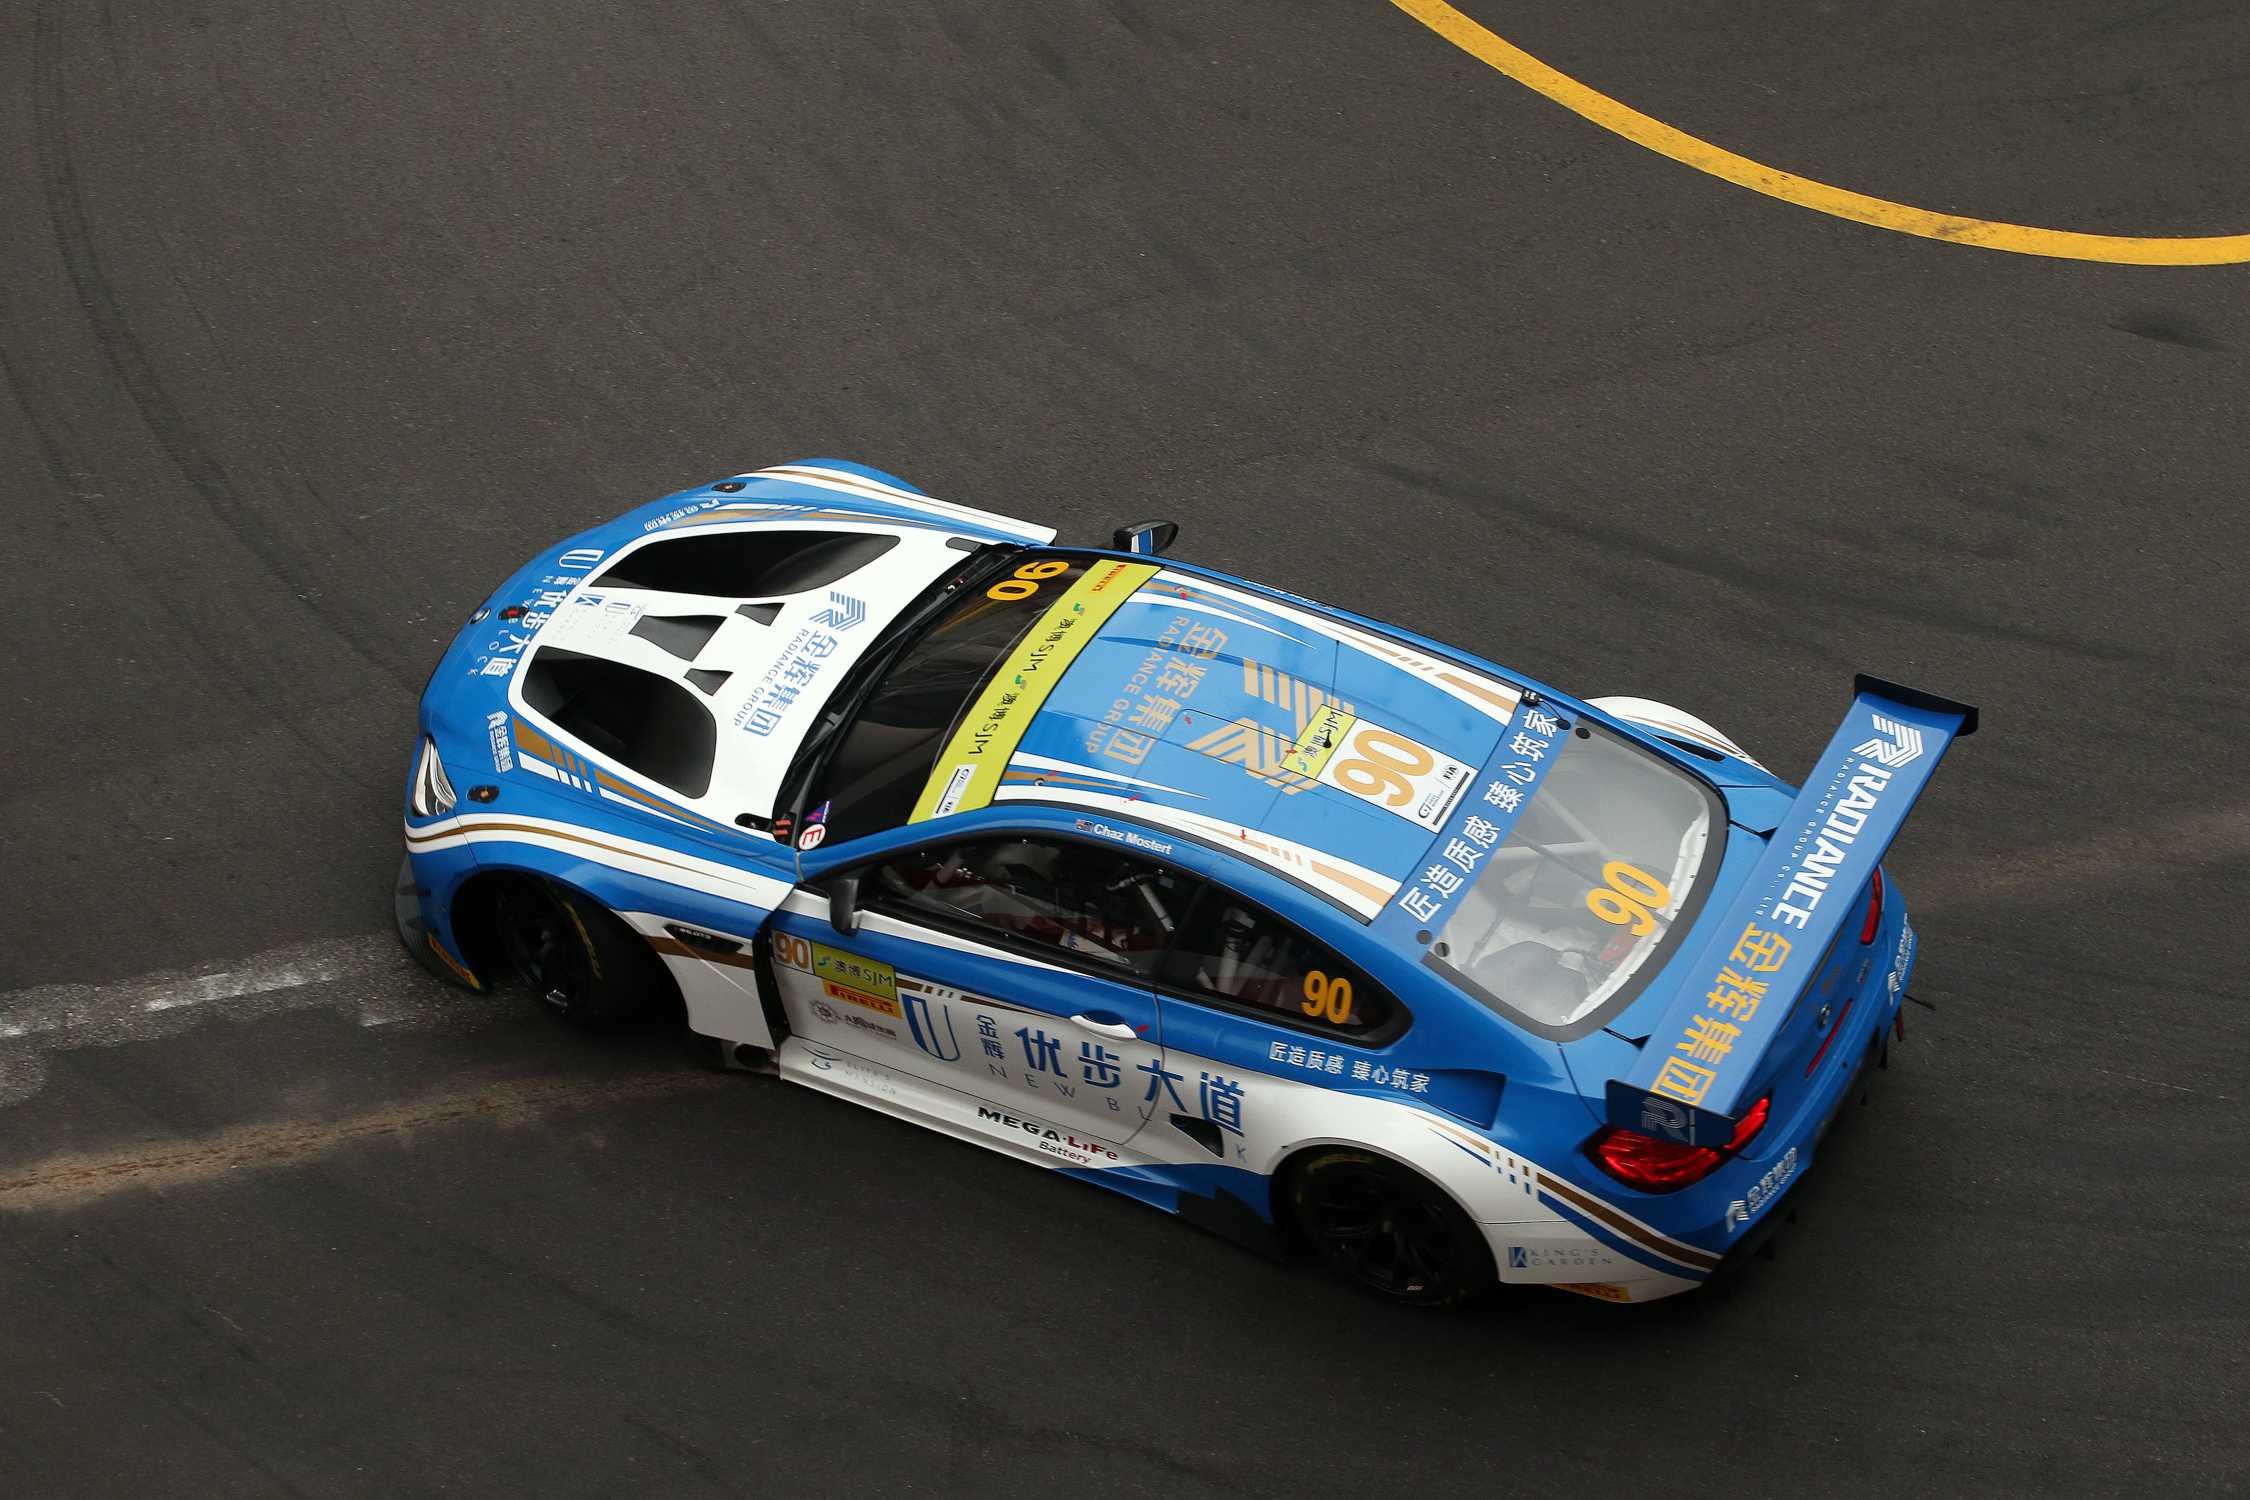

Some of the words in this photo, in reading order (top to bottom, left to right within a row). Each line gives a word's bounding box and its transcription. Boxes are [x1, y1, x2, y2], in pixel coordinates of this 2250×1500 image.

[986, 561, 1070, 601] 90
[743, 630, 838, 737] 金辉集团
[762, 628, 810, 685] RADIANCE
[1124, 615, 1190, 695] RADIANCE
[733, 686, 765, 727] GROUP
[1333, 729, 1434, 807] 90
[1815, 757, 1855, 815] RADIANCE
[1093, 823, 1125, 841] Chaz
[1125, 831, 1173, 855] Mostert
[1398, 814, 1500, 924] 匠造质感
[1483, 709, 1559, 814] 臻心筑家
[1790, 821, 1817, 858] GROUP
[1770, 762, 1893, 930] RADIANCE
[1585, 860, 1671, 937] 90
[774, 932, 809, 969] 90
[1301, 970, 1353, 1024] 90
[1650, 921, 1792, 1106] 金辉集团
[976, 1014, 1006, 1060] 金辉
[1014, 1025, 1245, 1137] 优步大道
[1268, 1041, 1345, 1074] 匠造质感
[1351, 1060, 1431, 1094] 臻心筑家
[1038, 1140, 1093, 1165] Battery
